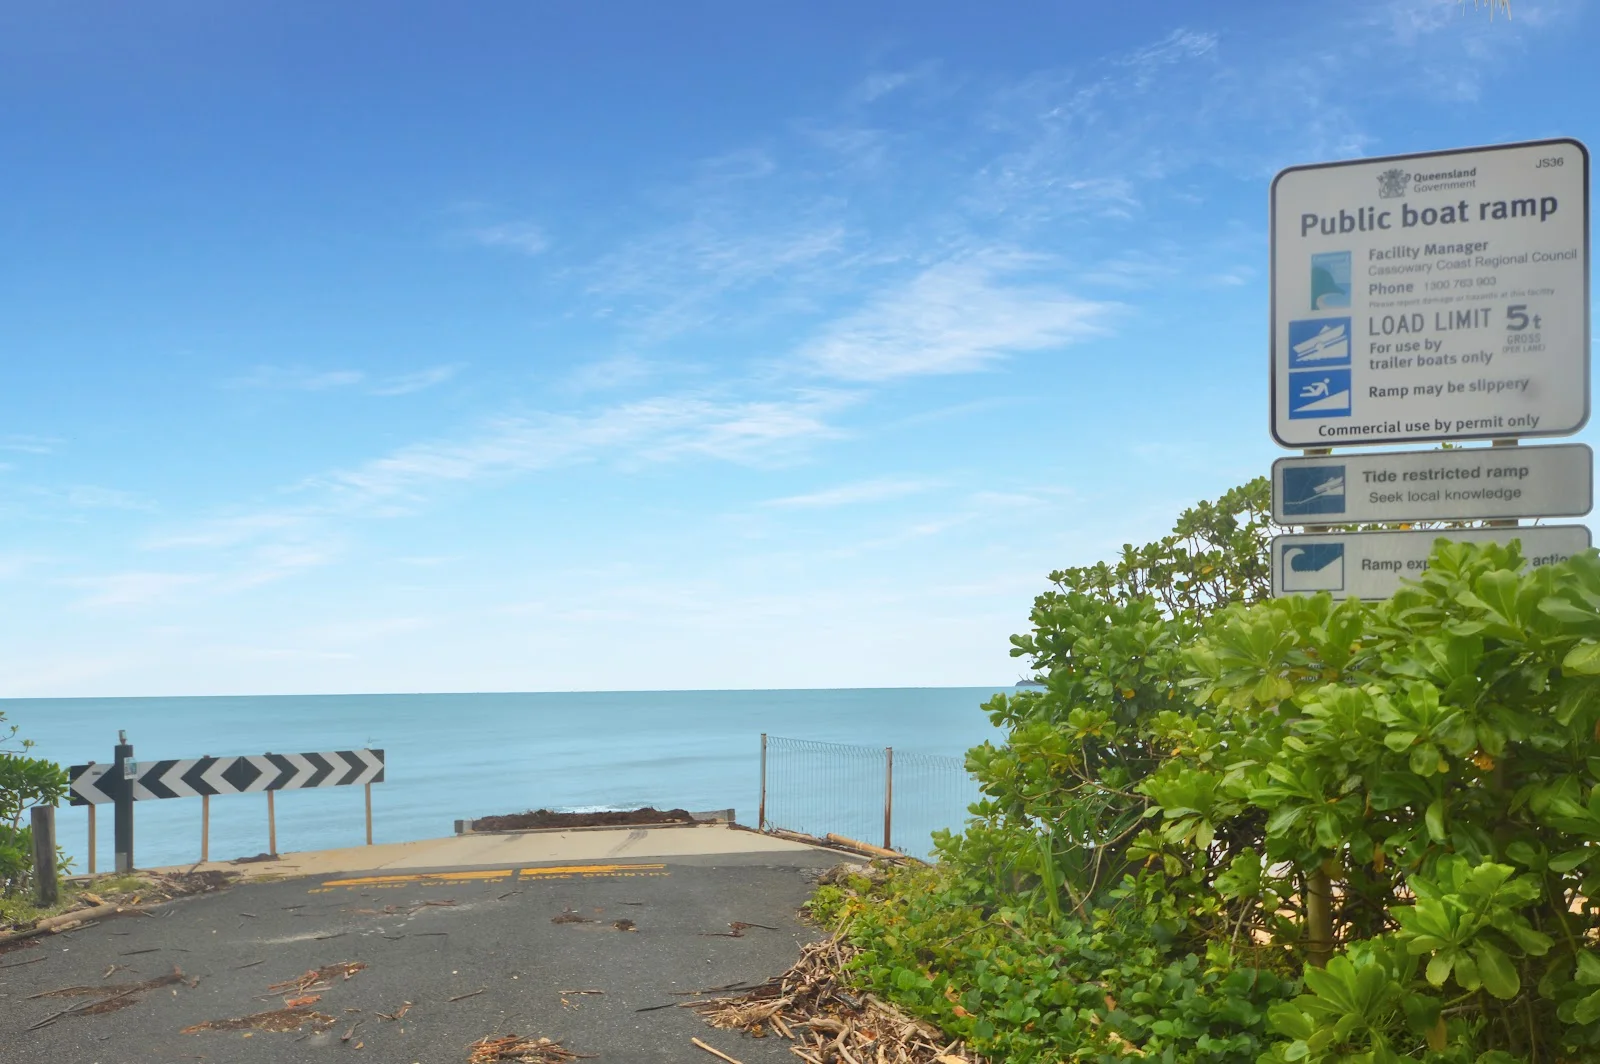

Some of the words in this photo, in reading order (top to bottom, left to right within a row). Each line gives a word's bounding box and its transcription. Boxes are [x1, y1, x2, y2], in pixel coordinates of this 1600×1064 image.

[1535, 157, 1564, 169] JS36
[1413, 168, 1477, 183] Queensland
[1413, 180, 1476, 193] Government
[1300, 206, 1392, 237] Public
[1402, 199, 1469, 228] boat
[1479, 195, 1558, 222] ramp
[1369, 247, 1420, 261] Facility
[1423, 240, 1489, 257] Manager
[1368, 262, 1433, 277] Cassowary
[1436, 257, 1472, 271] Coast
[1475, 252, 1528, 269] Regional
[1532, 248, 1578, 264] Council
[1368, 282, 1414, 296] Phone
[1424, 279, 1450, 291] 1300
[1368, 313, 1425, 336] LOAD
[1435, 308, 1492, 331] LIMIT
[1369, 342, 1392, 355] For
[1396, 341, 1421, 353] use
[1425, 338, 1442, 353] by
[1507, 333, 1542, 345] GROSS
[1369, 356, 1413, 370] trailer
[1417, 353, 1458, 367] boats
[1461, 351, 1493, 367] only
[1369, 385, 1409, 400] Ramp
[1413, 383, 1443, 398] may
[1447, 380, 1465, 394] be
[1468, 378, 1531, 395] slippery
[1318, 420, 1401, 437] Commercial
[1405, 421, 1431, 433] use
[1434, 419, 1452, 434] by
[1455, 416, 1504, 433] permit
[1507, 414, 1540, 430] only
[1362, 469, 1397, 483] Tide
[1402, 467, 1482, 482] restricted
[1486, 466, 1530, 481] ramp
[1369, 491, 1404, 504] Seek
[1407, 489, 1440, 503] local
[1444, 487, 1522, 502] knowledge
[1361, 558, 1403, 573] Ramp
[1532, 553, 1569, 567] actio
